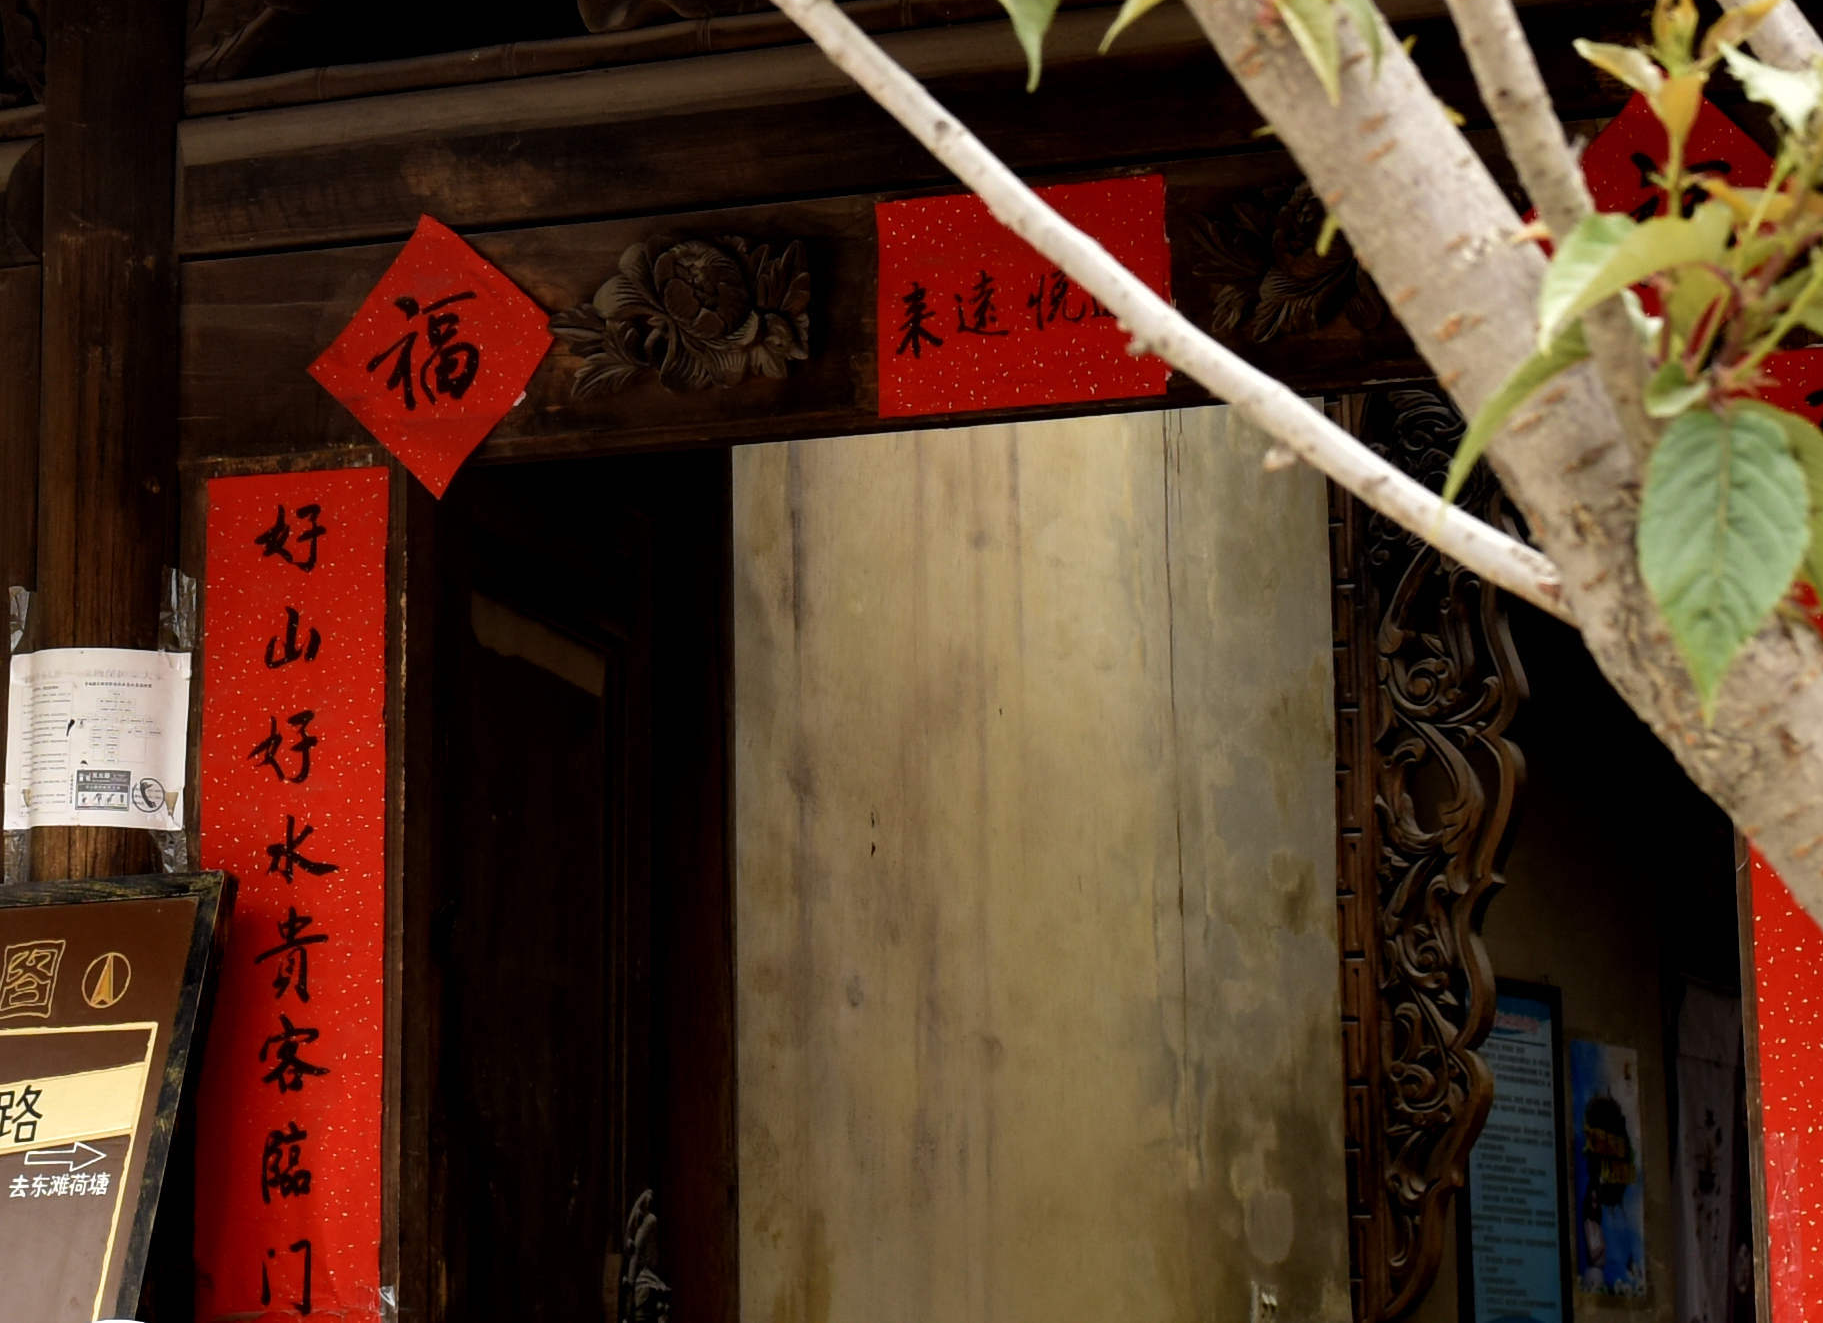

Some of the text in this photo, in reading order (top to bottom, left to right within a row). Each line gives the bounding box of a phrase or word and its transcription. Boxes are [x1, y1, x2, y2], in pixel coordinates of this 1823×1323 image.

[366, 290, 477, 409] 福
[8, 1173, 111, 1198] 去东滩荷塘
